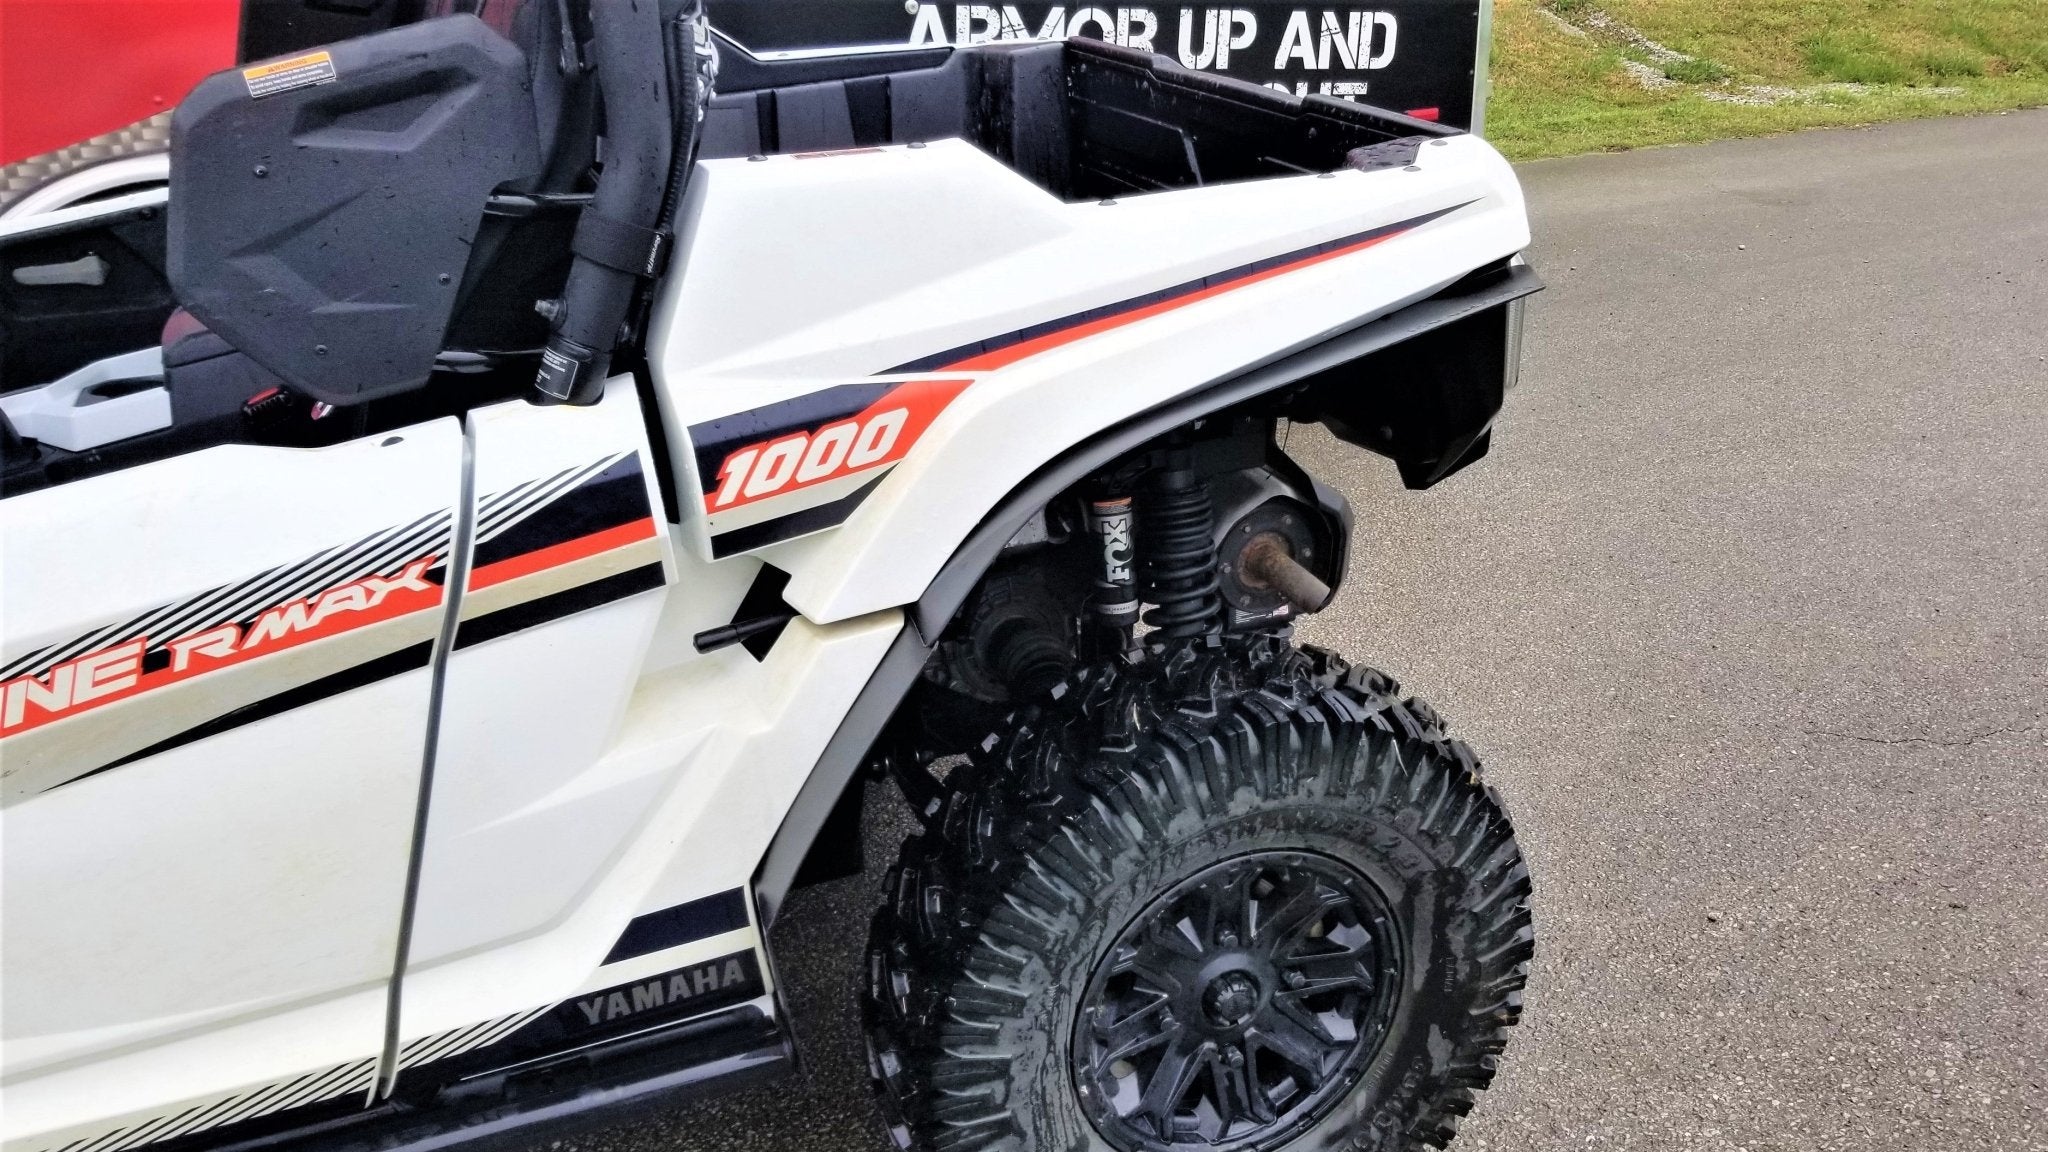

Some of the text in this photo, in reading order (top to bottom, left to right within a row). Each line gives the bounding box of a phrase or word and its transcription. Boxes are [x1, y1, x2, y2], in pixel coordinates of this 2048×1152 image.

[908, 4, 1396, 70] ARMOR UP AND
[715, 407, 909, 507] 1000
[1103, 519, 1133, 582] FOX
[0, 559, 434, 729] NE RMAX
[577, 958, 746, 1025] YAMAHA
